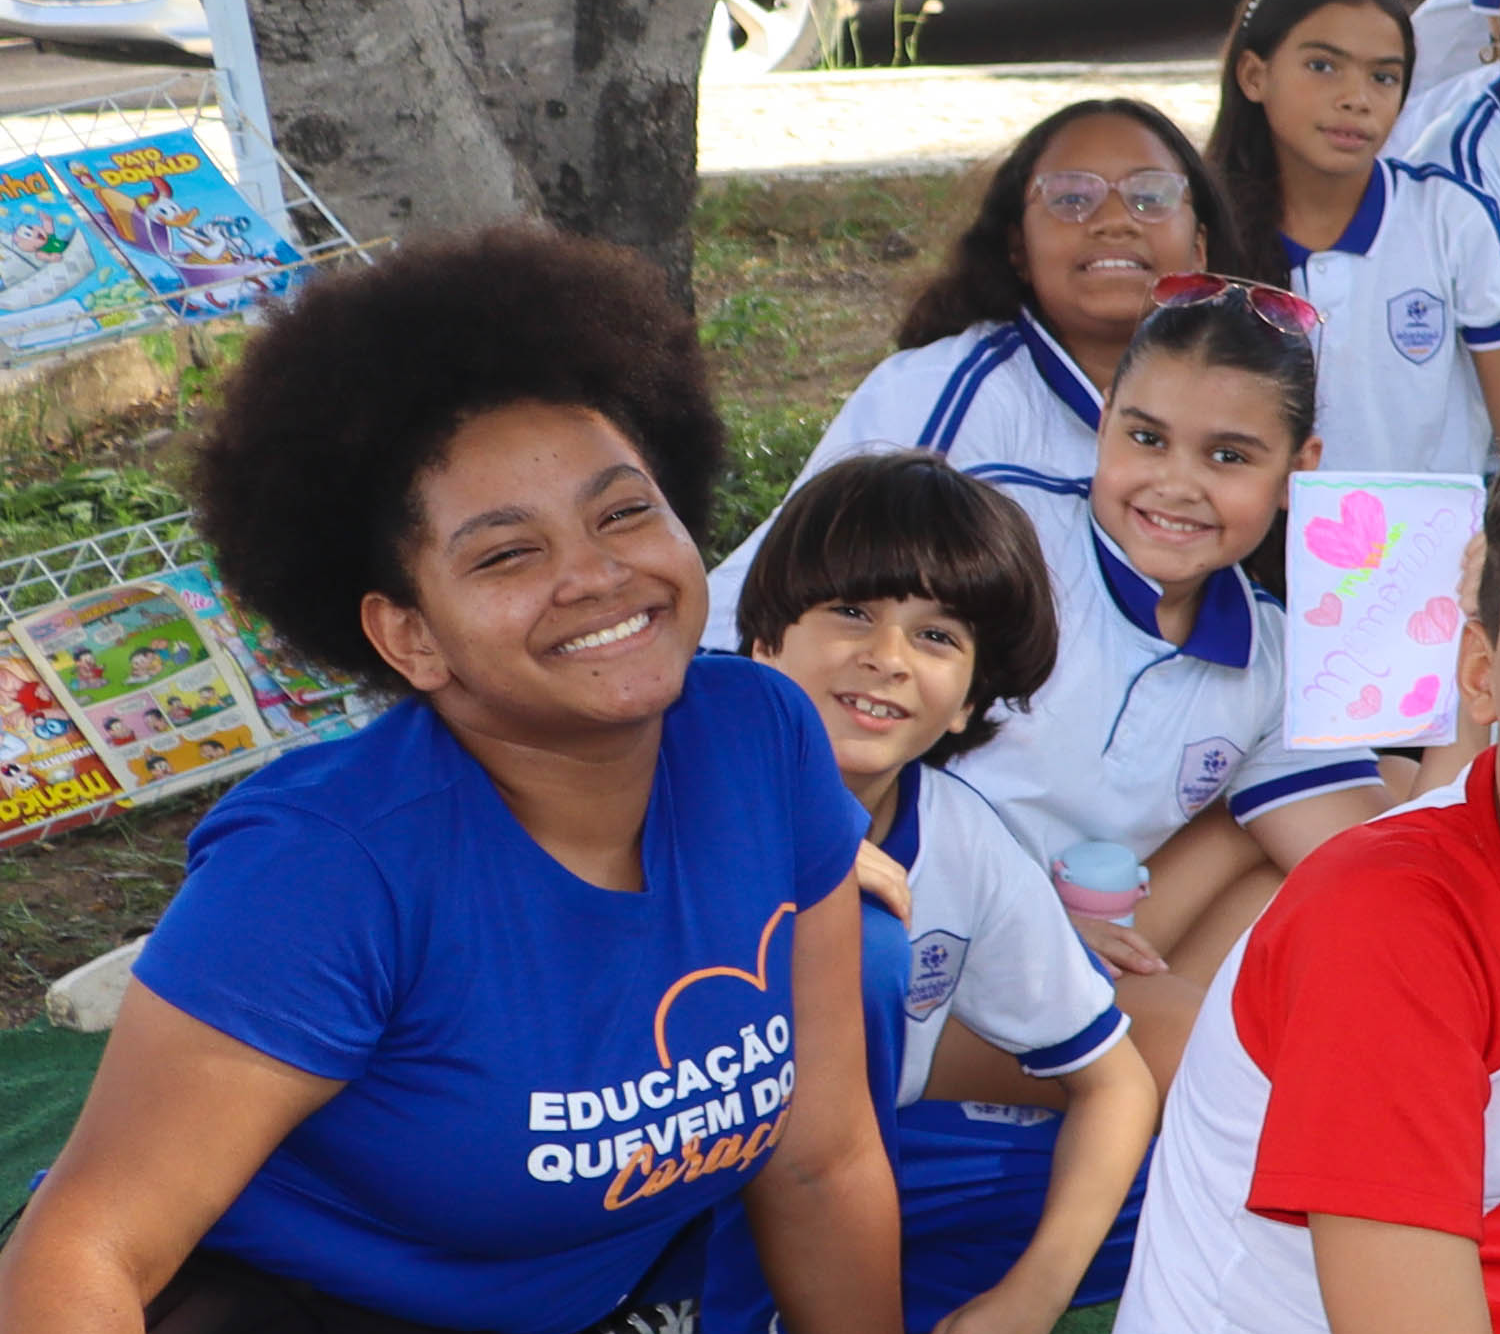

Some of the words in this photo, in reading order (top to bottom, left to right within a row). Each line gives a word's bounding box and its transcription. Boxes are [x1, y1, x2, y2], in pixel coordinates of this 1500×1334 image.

[99, 153, 200, 188] DONALD
[111, 147, 163, 168] PATO
[529, 1014, 790, 1132] EDUCAÇÃO
[751, 1060, 796, 1117] DO
